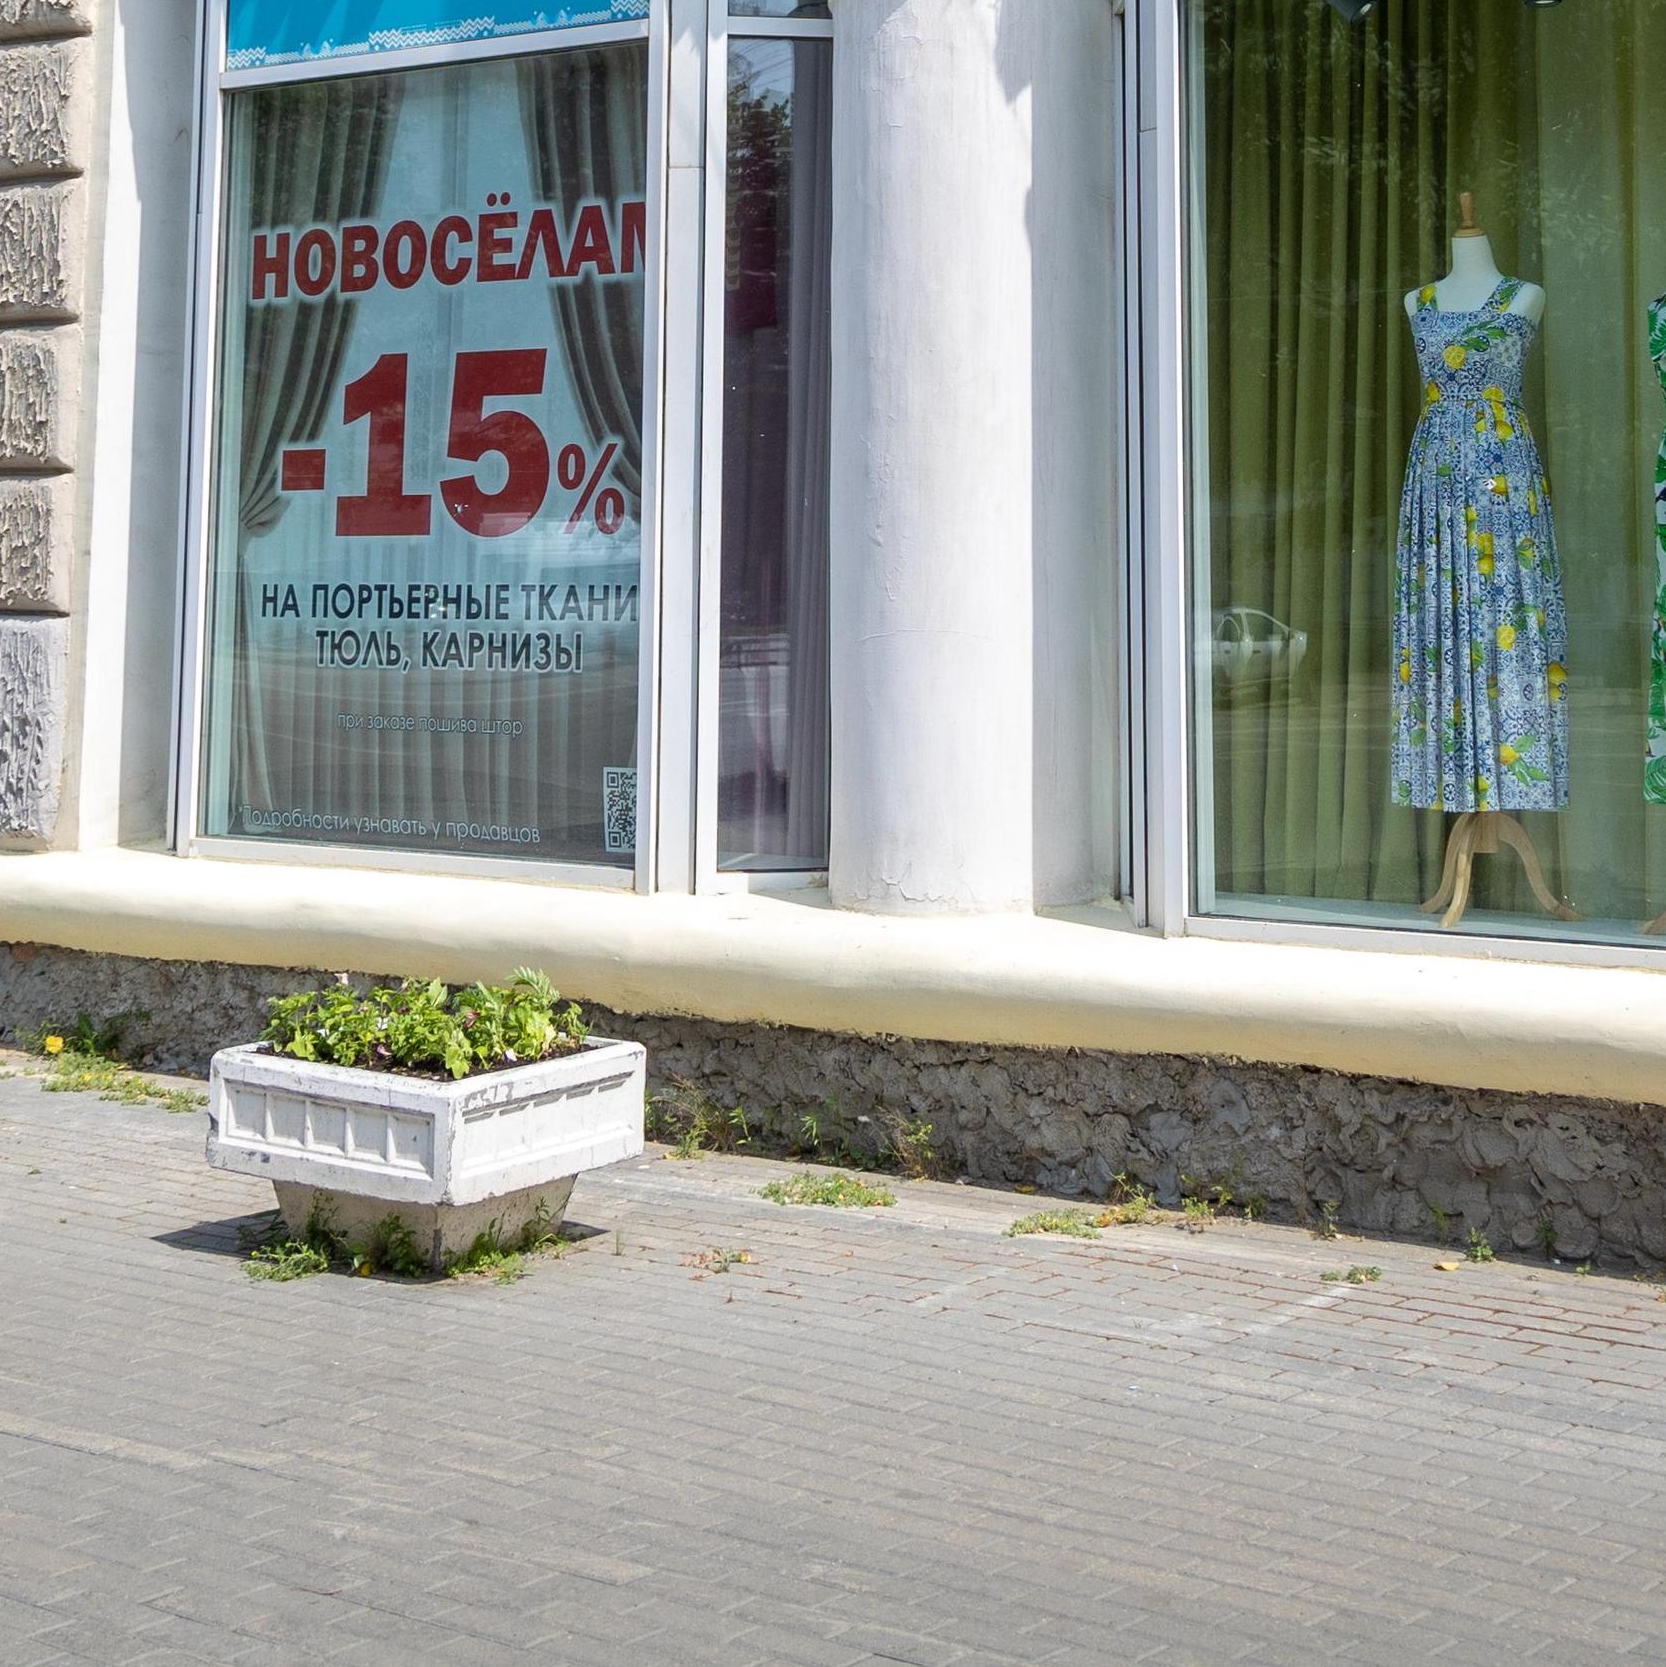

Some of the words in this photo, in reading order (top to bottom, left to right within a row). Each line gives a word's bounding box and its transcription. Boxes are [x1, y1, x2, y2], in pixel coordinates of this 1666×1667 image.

[281, 347, 625, 538] -15%
[261, 583, 300, 619] НА
[311, 583, 510, 621] ПОРТЬЕРНЫЕ
[520, 584, 638, 622] ТКАНИ
[315, 630, 411, 673] ТЮЛЬ,
[421, 631, 583, 672] КАРНИЗЫ
[337, 713, 364, 731] при
[367, 714, 415, 731] заказе
[419, 717, 477, 733] пошива
[482, 718, 525, 738] штор
[354, 816, 427, 837] узнавать
[431, 821, 441, 841] у
[446, 821, 541, 844] продавцов
